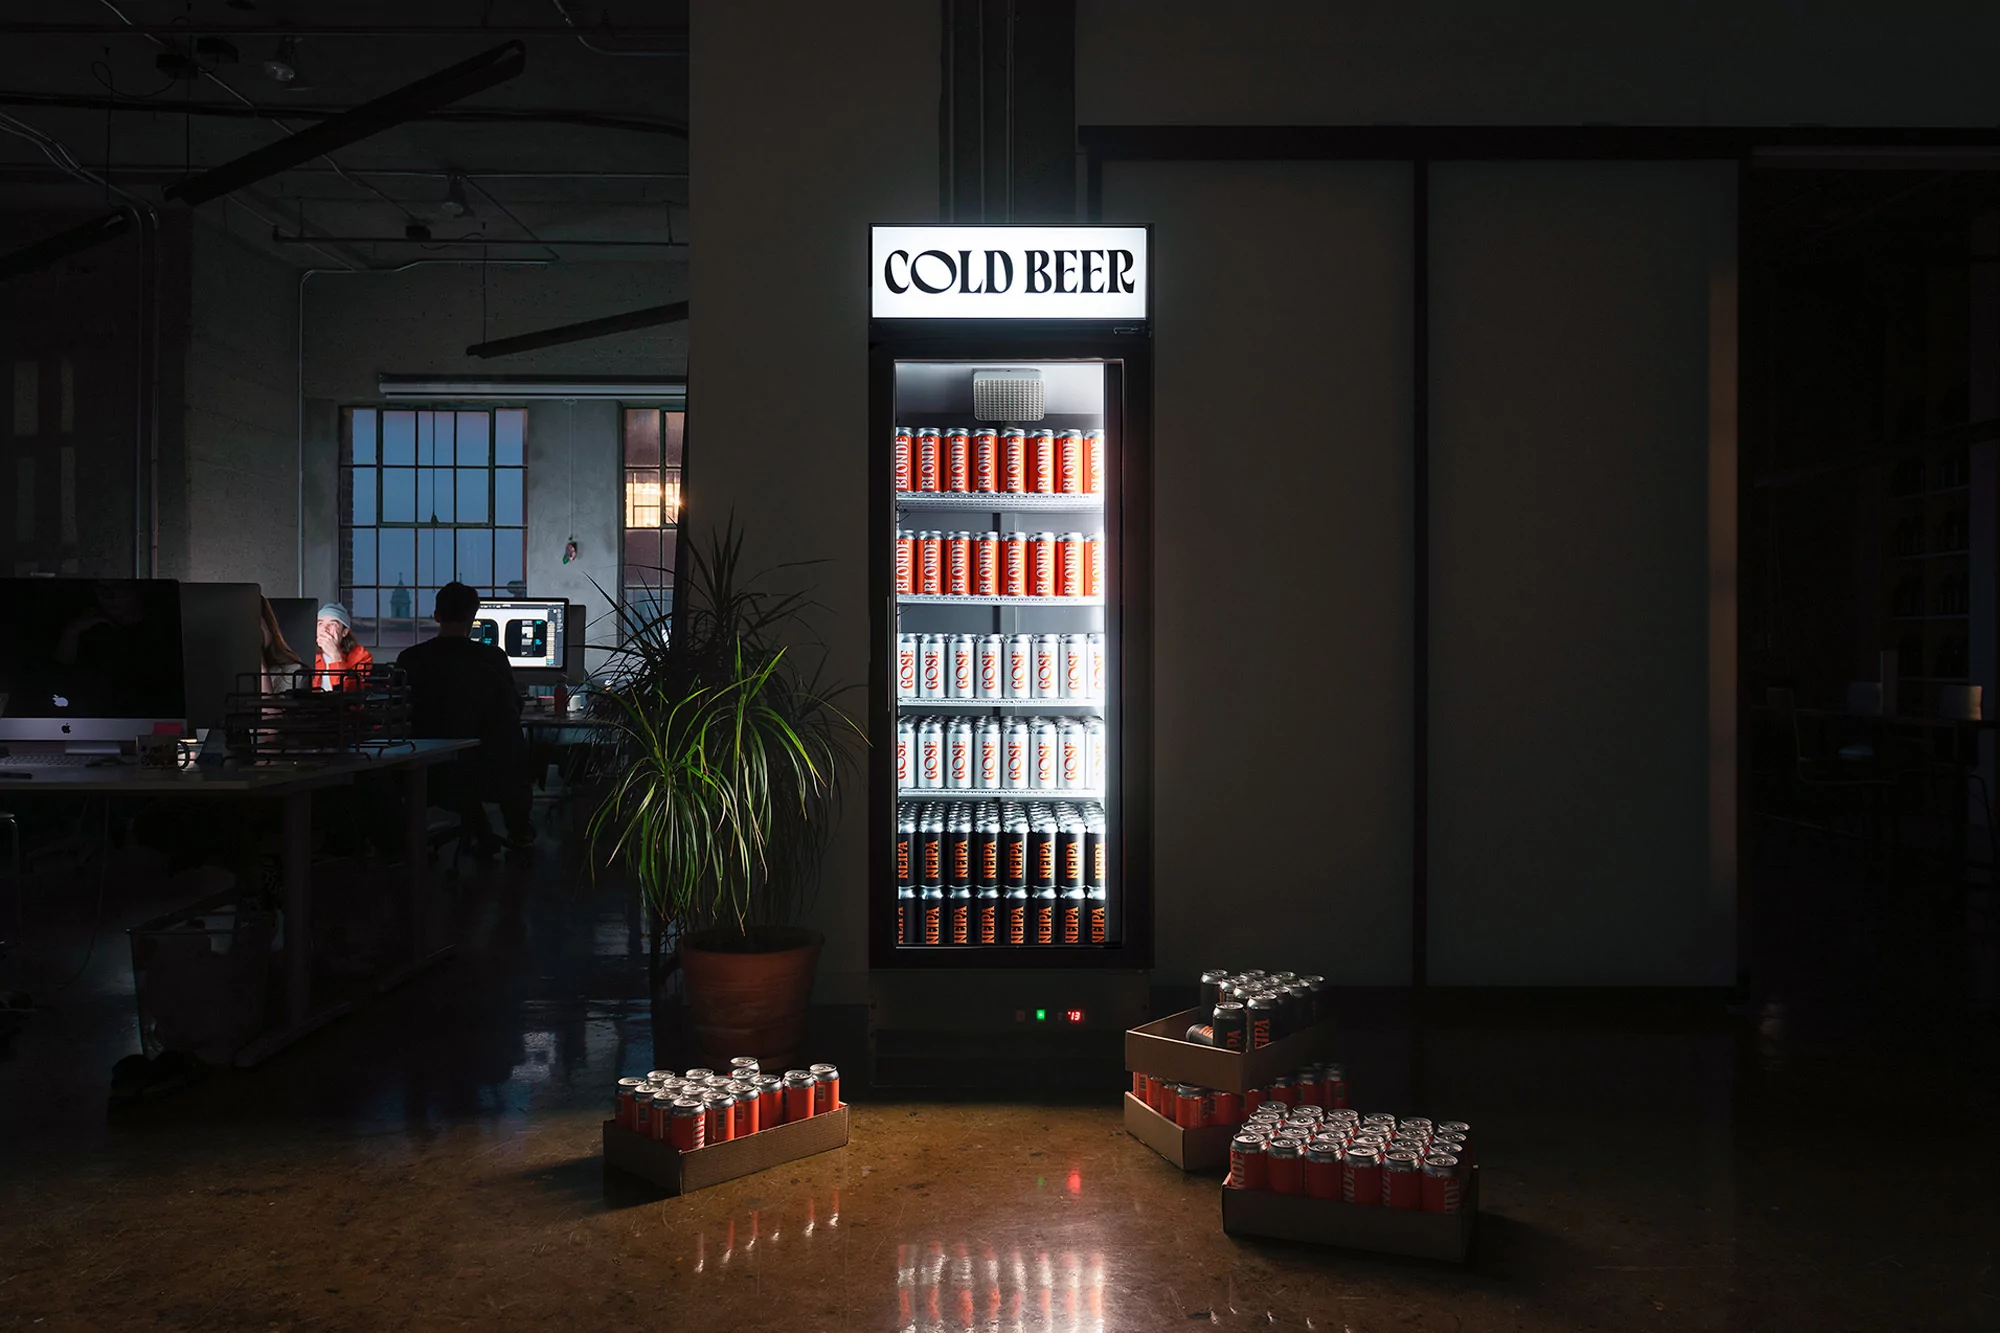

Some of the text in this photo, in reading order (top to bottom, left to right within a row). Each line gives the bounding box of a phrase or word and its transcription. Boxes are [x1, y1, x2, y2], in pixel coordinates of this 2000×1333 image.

[884, 249, 1136, 294] COLD BEER
[896, 436, 908, 489] BLONDE
[922, 436, 935, 490] BLONDE
[952, 436, 964, 490] BLONDE
[978, 436, 992, 490] BLONDE
[1007, 437, 1020, 491] BLONDE
[1038, 437, 1050, 491] BLONDE
[1062, 437, 1076, 491] BLONDE
[897, 539, 909, 592] BLONDE
[924, 540, 937, 593] BLONDE
[952, 540, 965, 593] BLONDE
[980, 540, 993, 593] BLONDE
[1008, 541, 1021, 594] BLONDE
[1036, 541, 1050, 594] BLONDE
[1064, 541, 1078, 595] BLONDE
[900, 650, 914, 689] GOSE
[925, 651, 938, 690] GOSE
[956, 650, 968, 689] GOSE
[982, 651, 996, 690] GOSE
[1011, 651, 1024, 690] GOSE
[1038, 651, 1052, 690] GOSE
[1068, 651, 1080, 690] GOSE
[924, 741, 937, 780] GOSE
[952, 741, 966, 780] GOSE
[982, 741, 995, 780] GOSE
[1008, 741, 1022, 780] GOSE
[1038, 741, 1052, 781] GOSE
[1064, 741, 1077, 781] GOSE
[898, 840, 908, 879] NEIPA
[926, 839, 939, 879] NEIPA
[954, 839, 968, 879] NEIPA
[984, 840, 997, 879] NEIPA
[1010, 840, 1022, 879] NEIPA
[1040, 842, 1052, 879] NEIPA
[1066, 841, 1078, 879] NEIPA
[926, 906, 940, 945] NEIPA
[954, 906, 968, 944] NEIPA
[982, 906, 995, 944] NEIPA
[1010, 906, 1024, 944] NEIPA
[1038, 906, 1052, 944] NEIPA
[1065, 906, 1078, 944] NEIPA
[1092, 906, 1104, 944] NEIPA
[1254, 1019, 1270, 1049] EIPA
[1230, 1152, 1246, 1190] NDE
